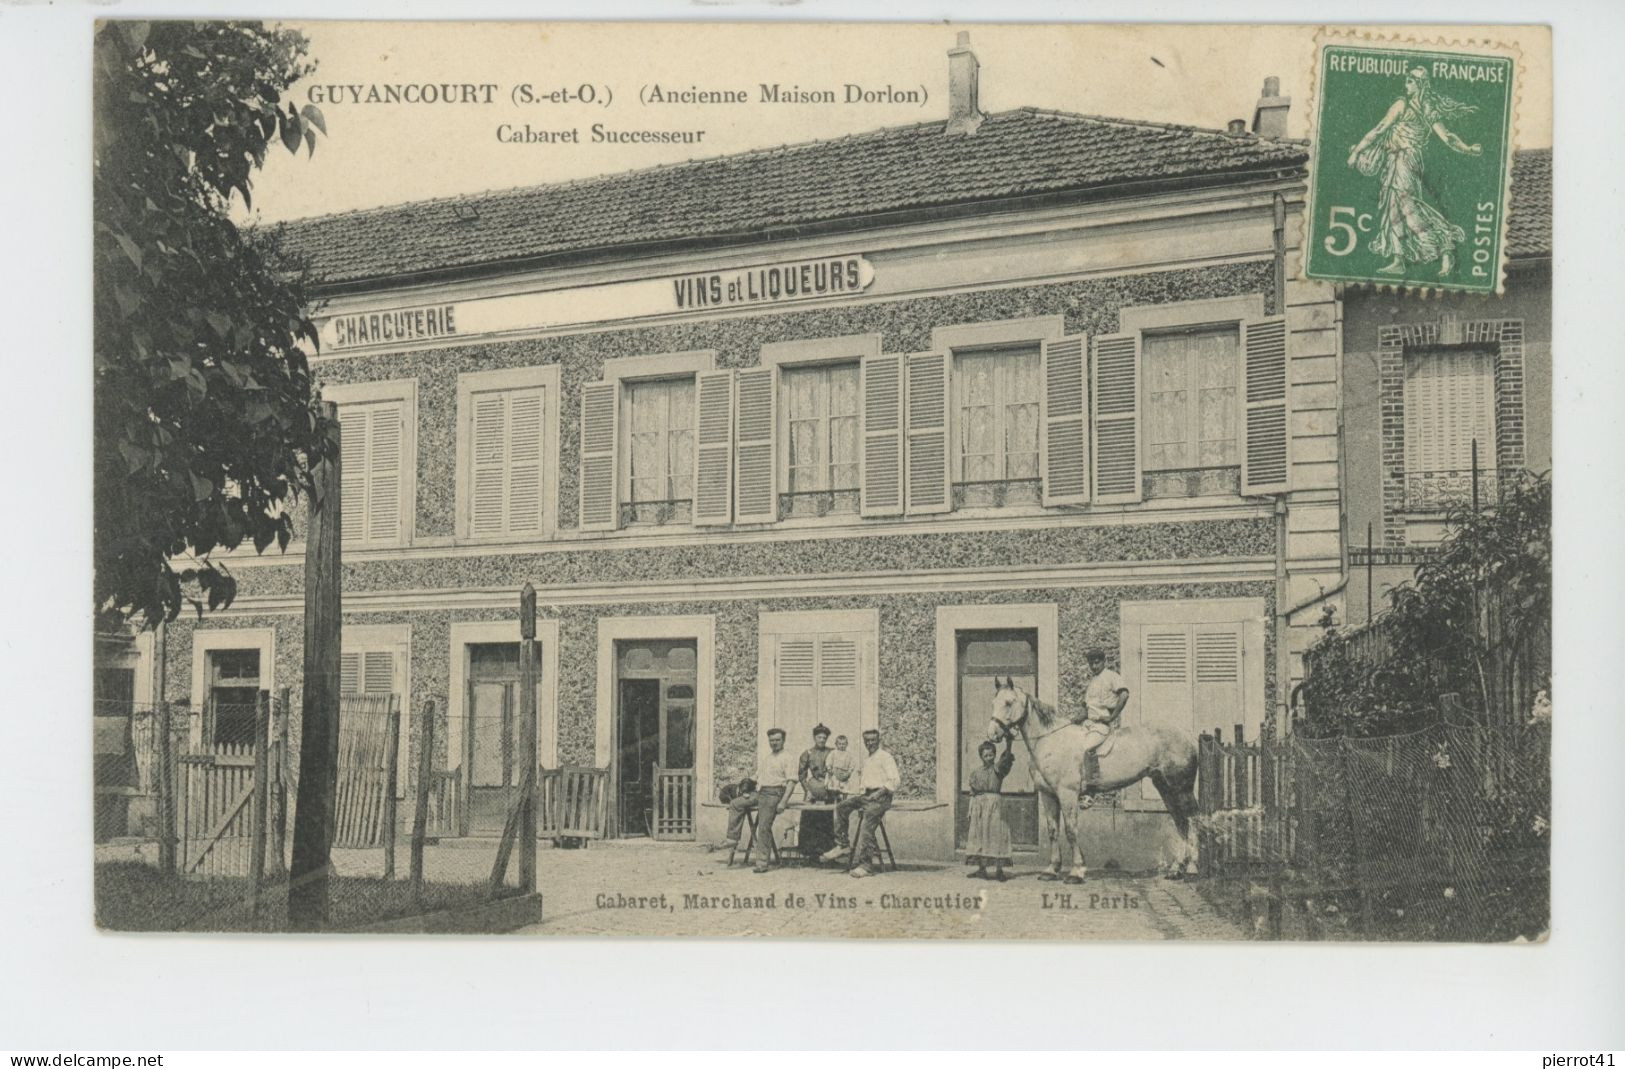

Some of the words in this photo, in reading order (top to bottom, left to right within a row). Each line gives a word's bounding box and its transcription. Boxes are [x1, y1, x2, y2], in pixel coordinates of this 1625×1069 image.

[1432, 62, 1504, 83] FRANÇAISE
[1472, 201, 1495, 277] POSTES
[673, 275, 722, 308] VINS
[728, 277, 743, 302] et
[748, 260, 860, 300] LIQUEURS
[335, 306, 455, 344] CHARCUTERIE
